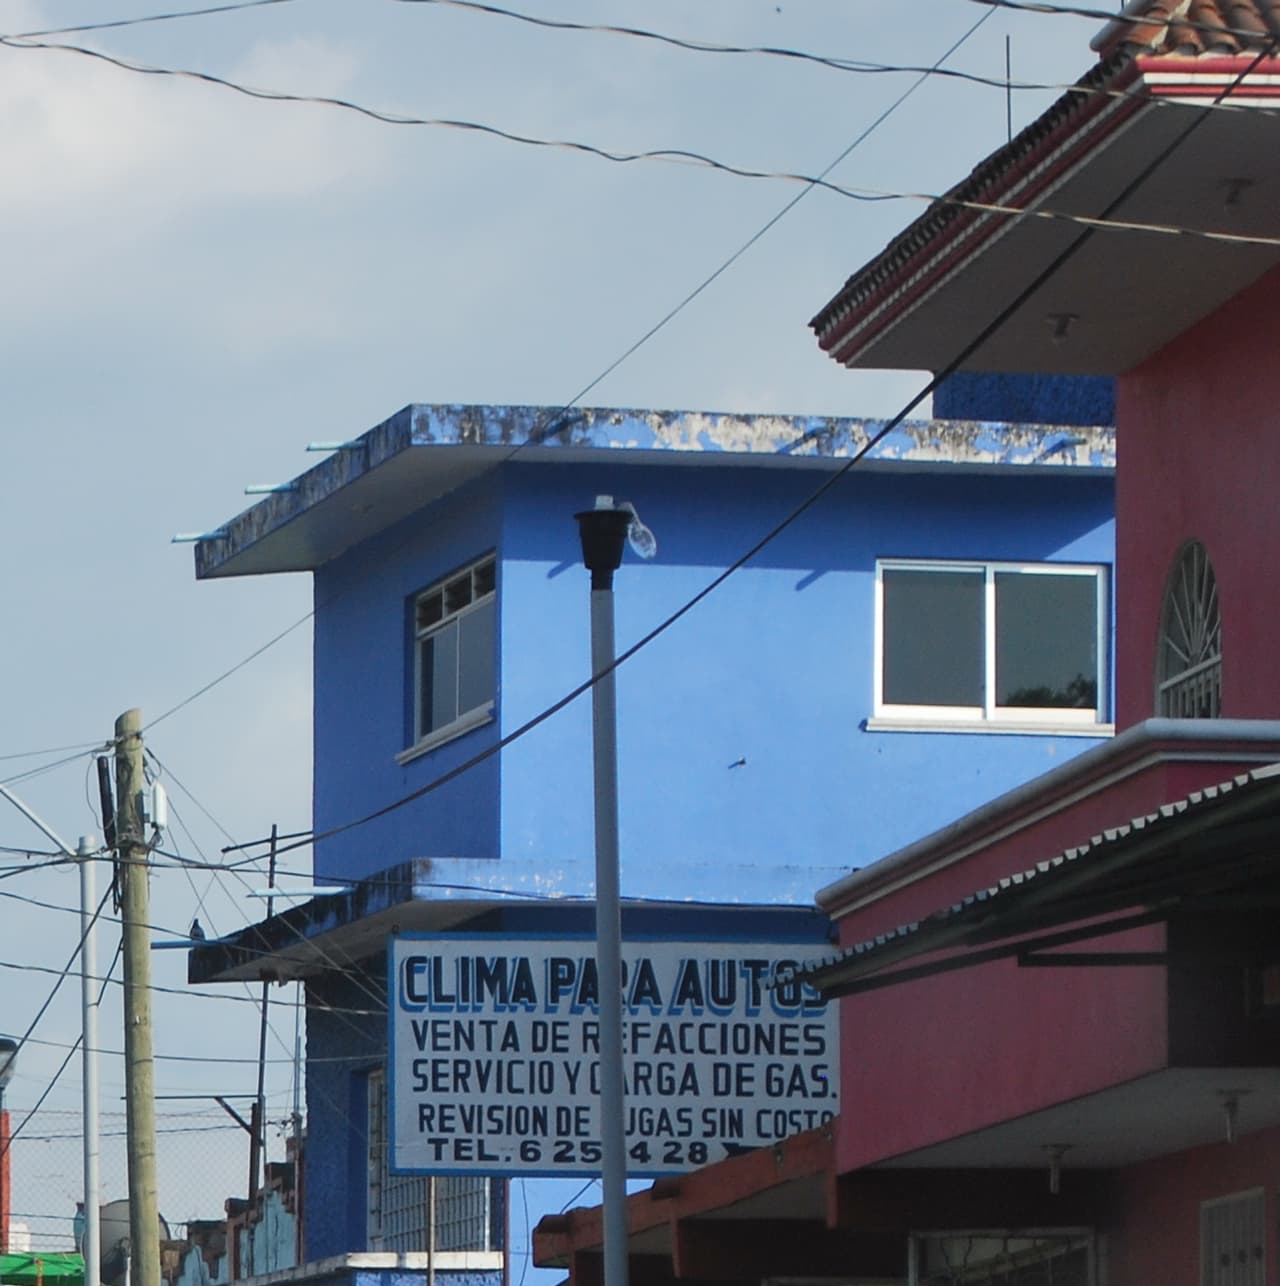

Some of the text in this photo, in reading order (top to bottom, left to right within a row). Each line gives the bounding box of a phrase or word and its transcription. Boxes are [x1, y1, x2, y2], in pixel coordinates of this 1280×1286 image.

[399, 955, 537, 1012] CLIMA
[411, 1019, 520, 1051] VENTA
[532, 1021, 569, 1053] DE
[412, 1058, 554, 1095] SERVICIO
[563, 1061, 581, 1095] Y
[713, 1063, 755, 1097] DE
[766, 1064, 837, 1099] GAS.
[419, 1103, 548, 1136] REVISION
[556, 1106, 590, 1137] DE
[625, 1107, 693, 1138] UGAS
[702, 1108, 743, 1139] SIN
[427, 1138, 512, 1162] TEL.
